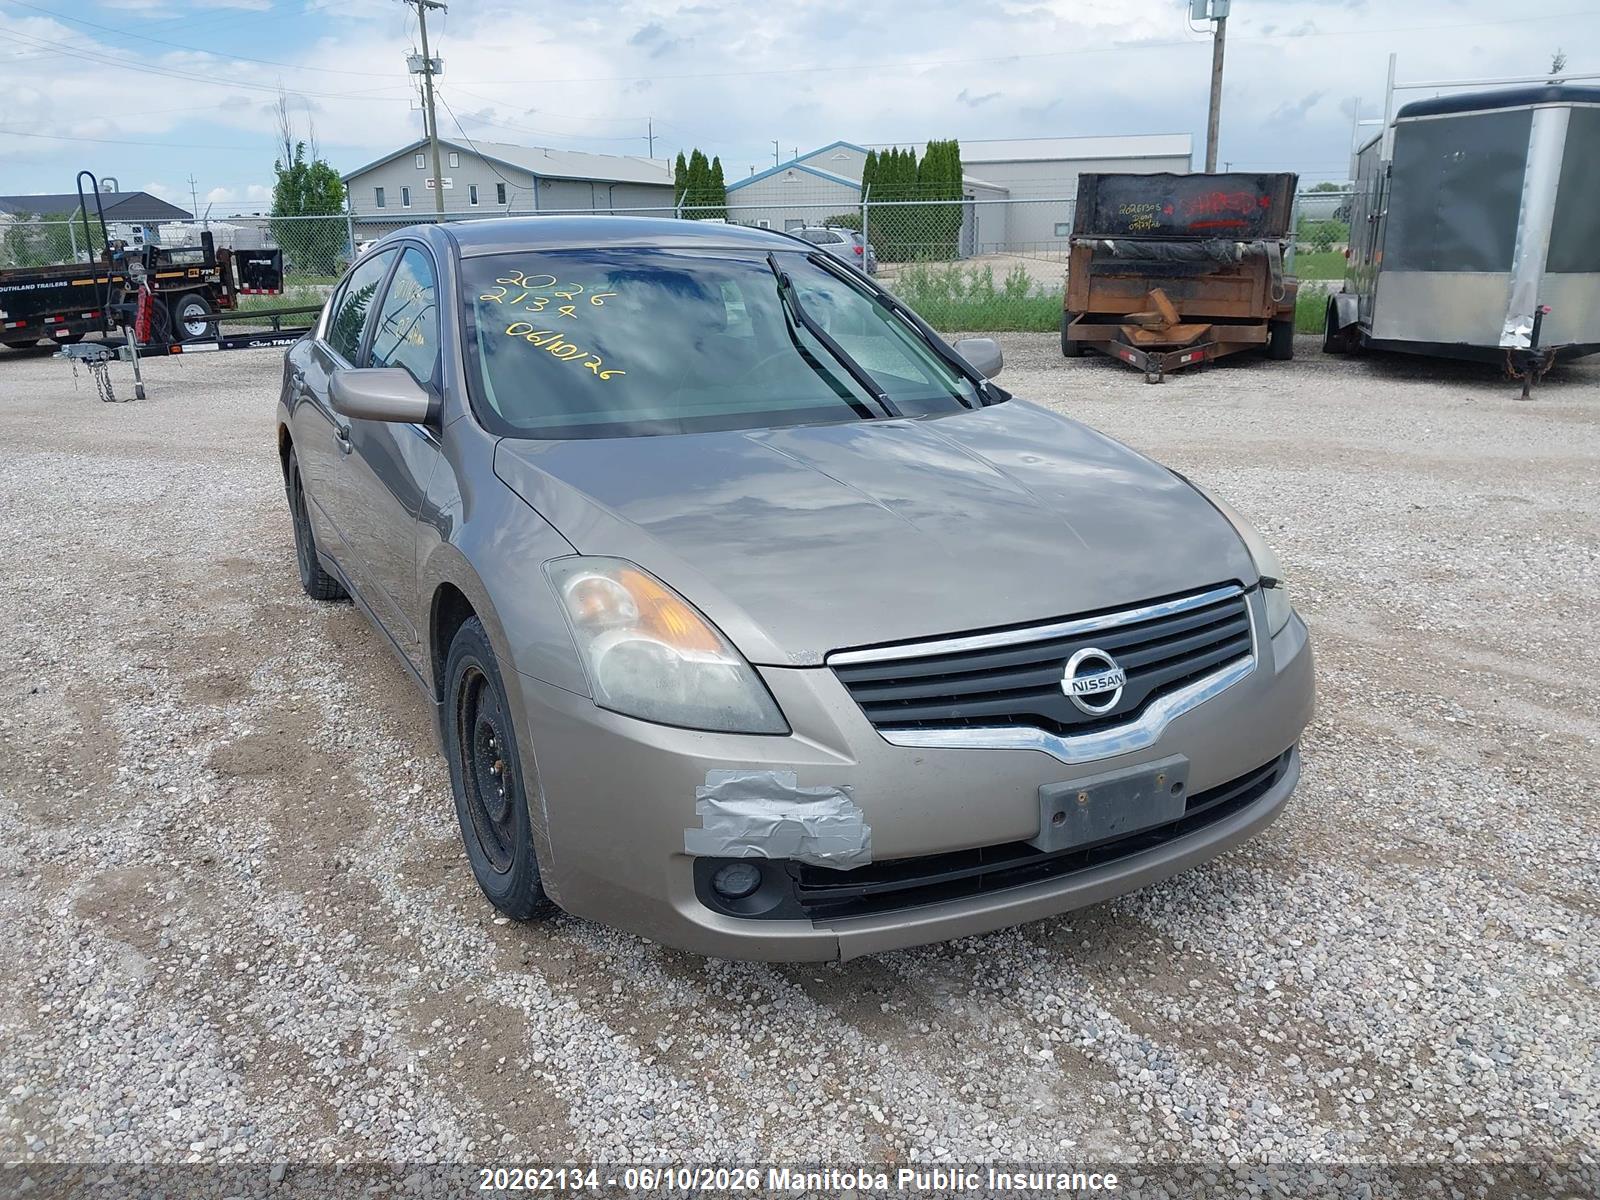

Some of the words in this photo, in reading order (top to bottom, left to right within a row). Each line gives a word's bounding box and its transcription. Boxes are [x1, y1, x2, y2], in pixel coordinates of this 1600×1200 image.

[36, 281, 68, 289] TRAILERS
[495, 270, 617, 306] 2026
[479, 286, 578, 319] 2134
[505, 322, 626, 380] 06/10/26
[1072, 673, 1123, 693] NISSAN
